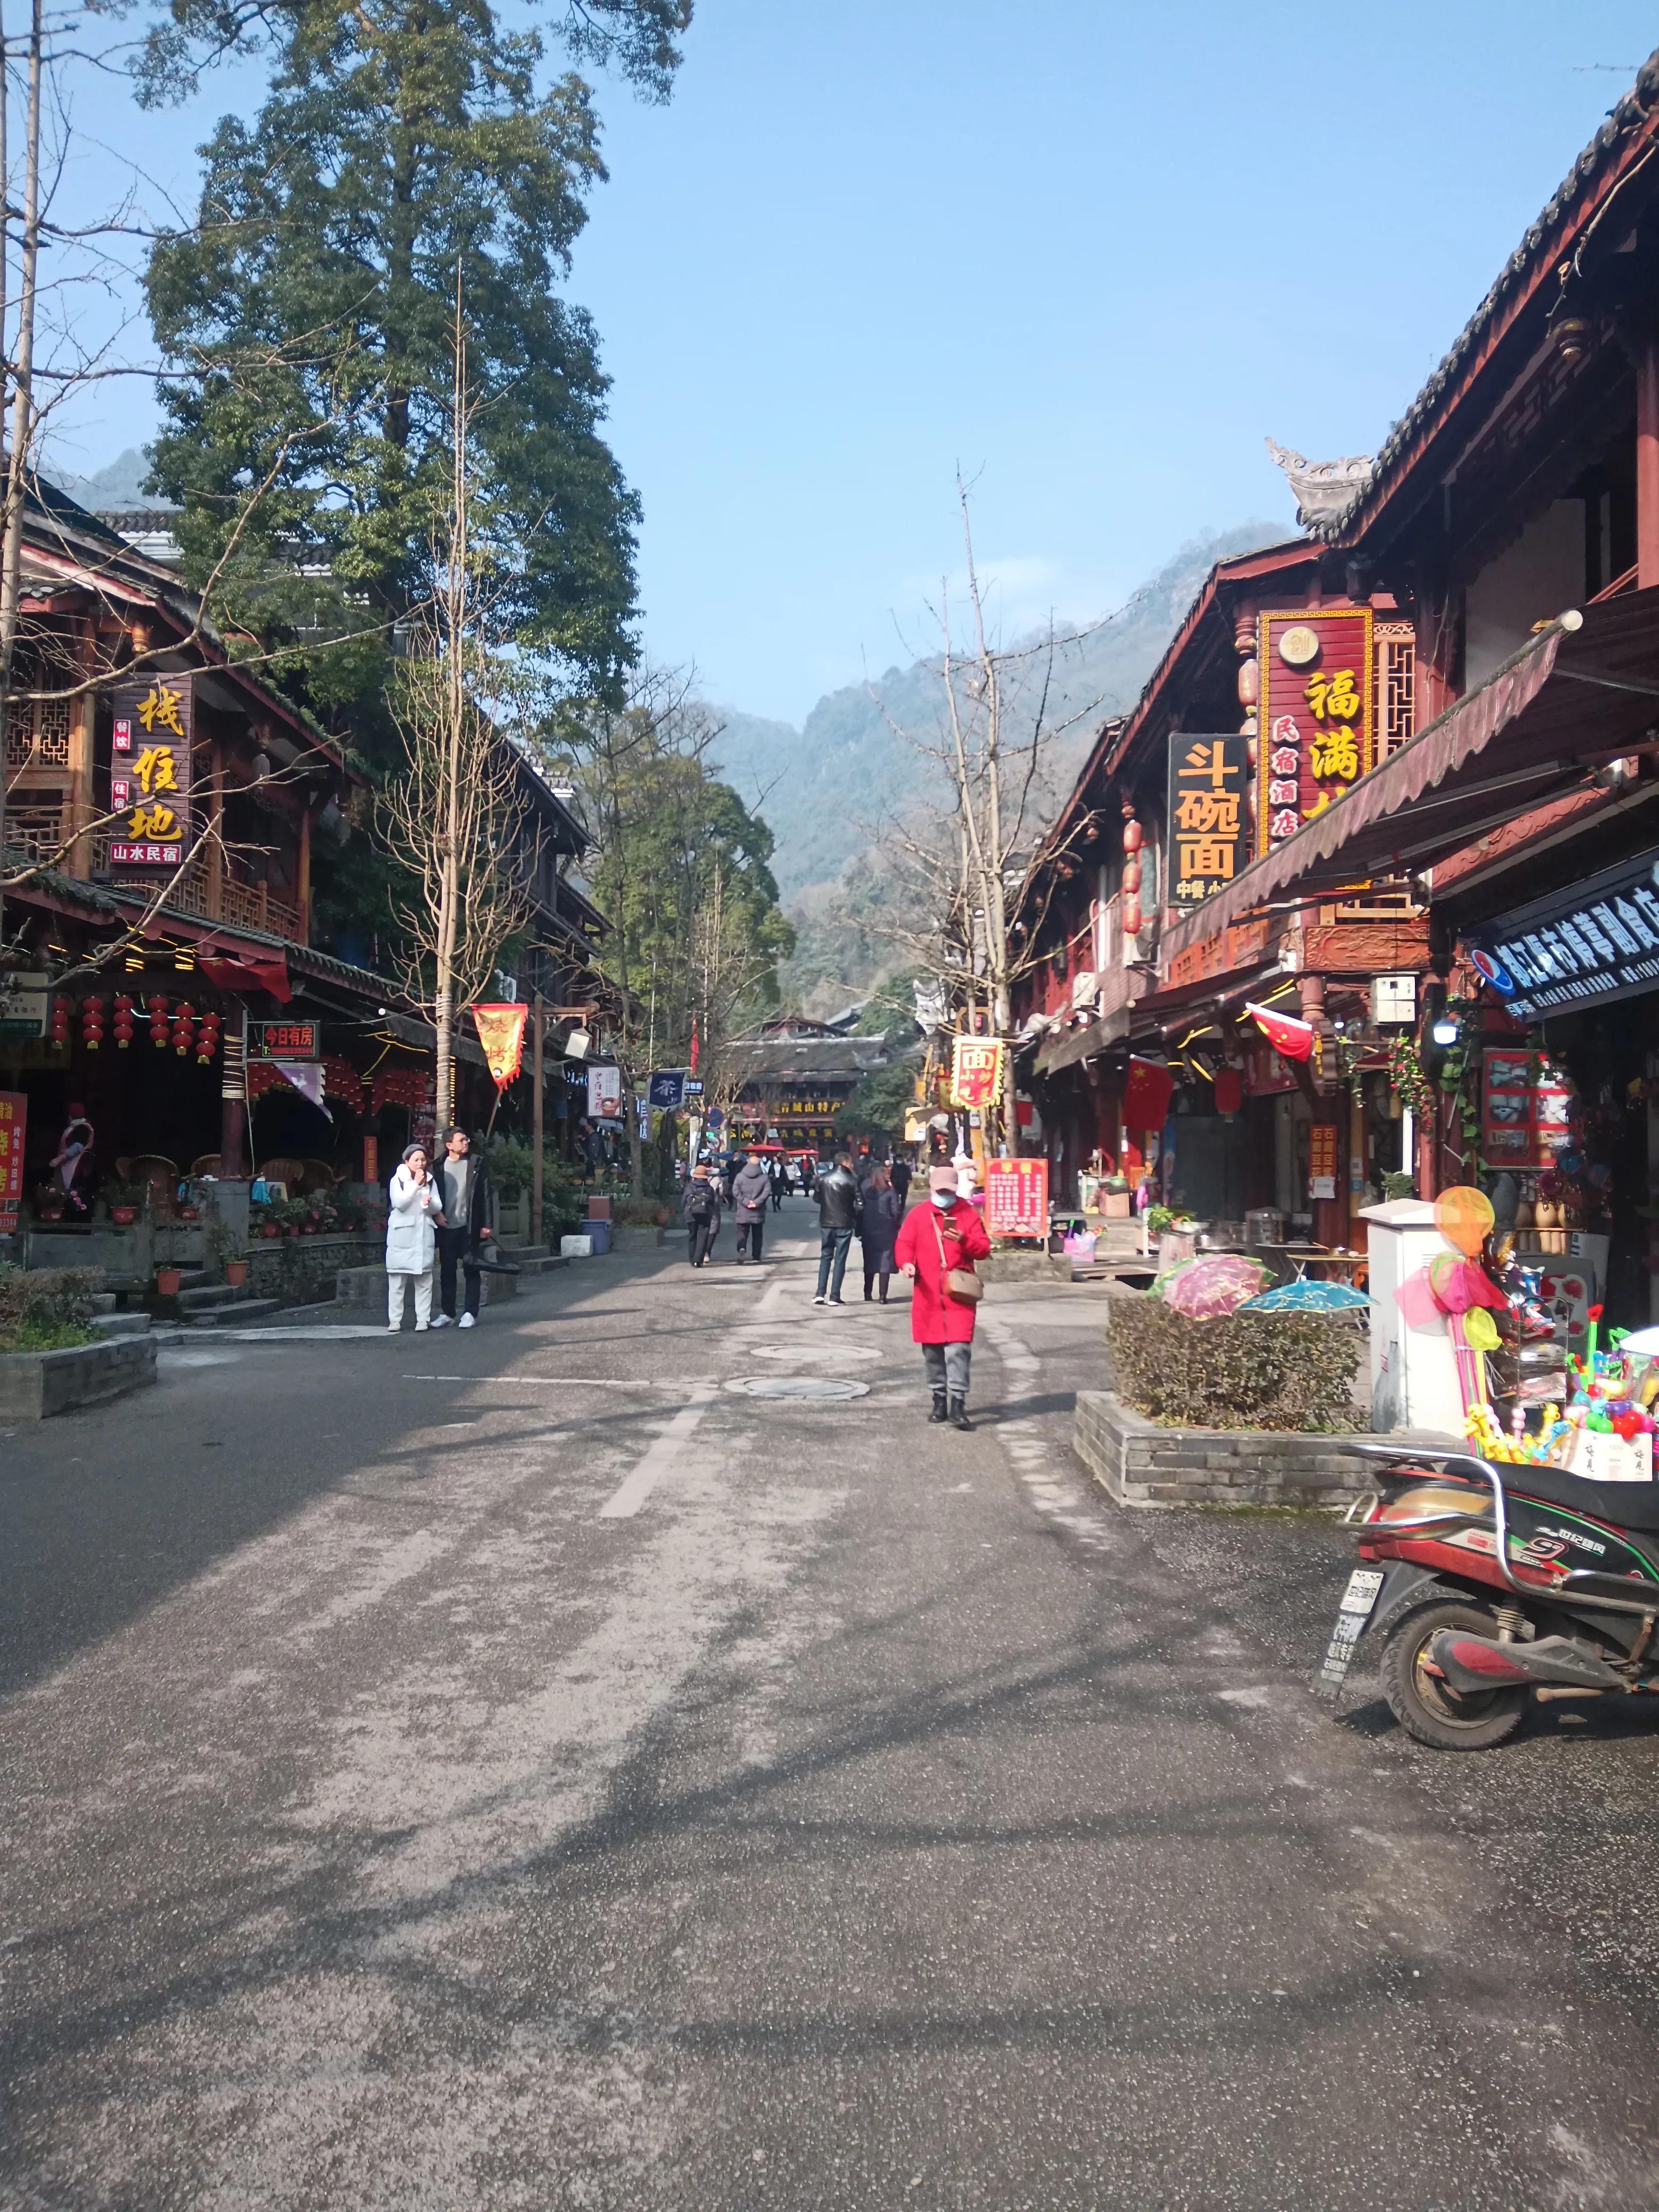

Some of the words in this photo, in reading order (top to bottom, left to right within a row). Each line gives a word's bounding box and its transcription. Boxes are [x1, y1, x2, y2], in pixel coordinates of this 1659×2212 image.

[116, 721, 128, 748] 餐饮
[1269, 715, 1300, 851] 民宿酒店
[114, 783, 127, 809] 住宿
[1175, 741, 1241, 879] 斗碗面
[113, 845, 178, 862] 山水民宿
[1176, 879, 1205, 899] 中餐
[265, 1025, 313, 1046] 今日有房
[485, 1017, 509, 1062] 烧烤
[961, 1045, 996, 1070] 面
[654, 1079, 680, 1096] 茶
